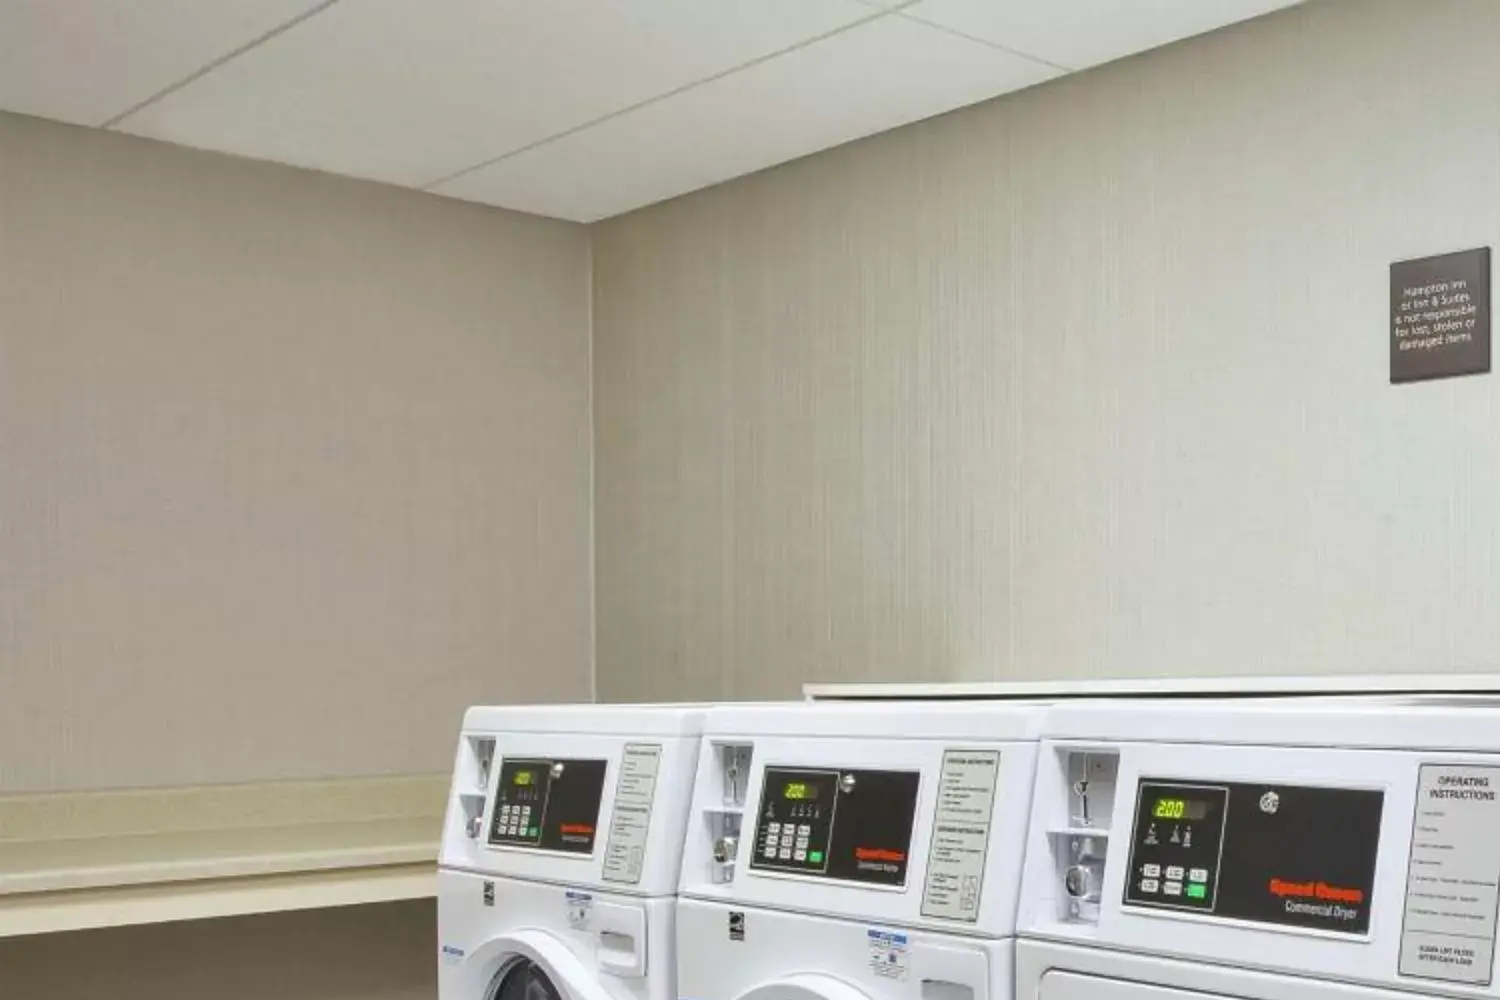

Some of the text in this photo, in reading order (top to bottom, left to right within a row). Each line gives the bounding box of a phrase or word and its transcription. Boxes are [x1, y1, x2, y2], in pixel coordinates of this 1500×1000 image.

[1403, 283, 1449, 298] Hampton
[1438, 775, 1489, 787] OPERATING
[1430, 789, 1495, 801] INSTRUCTIONS
[1285, 899, 1357, 921] Commercial Dryer
